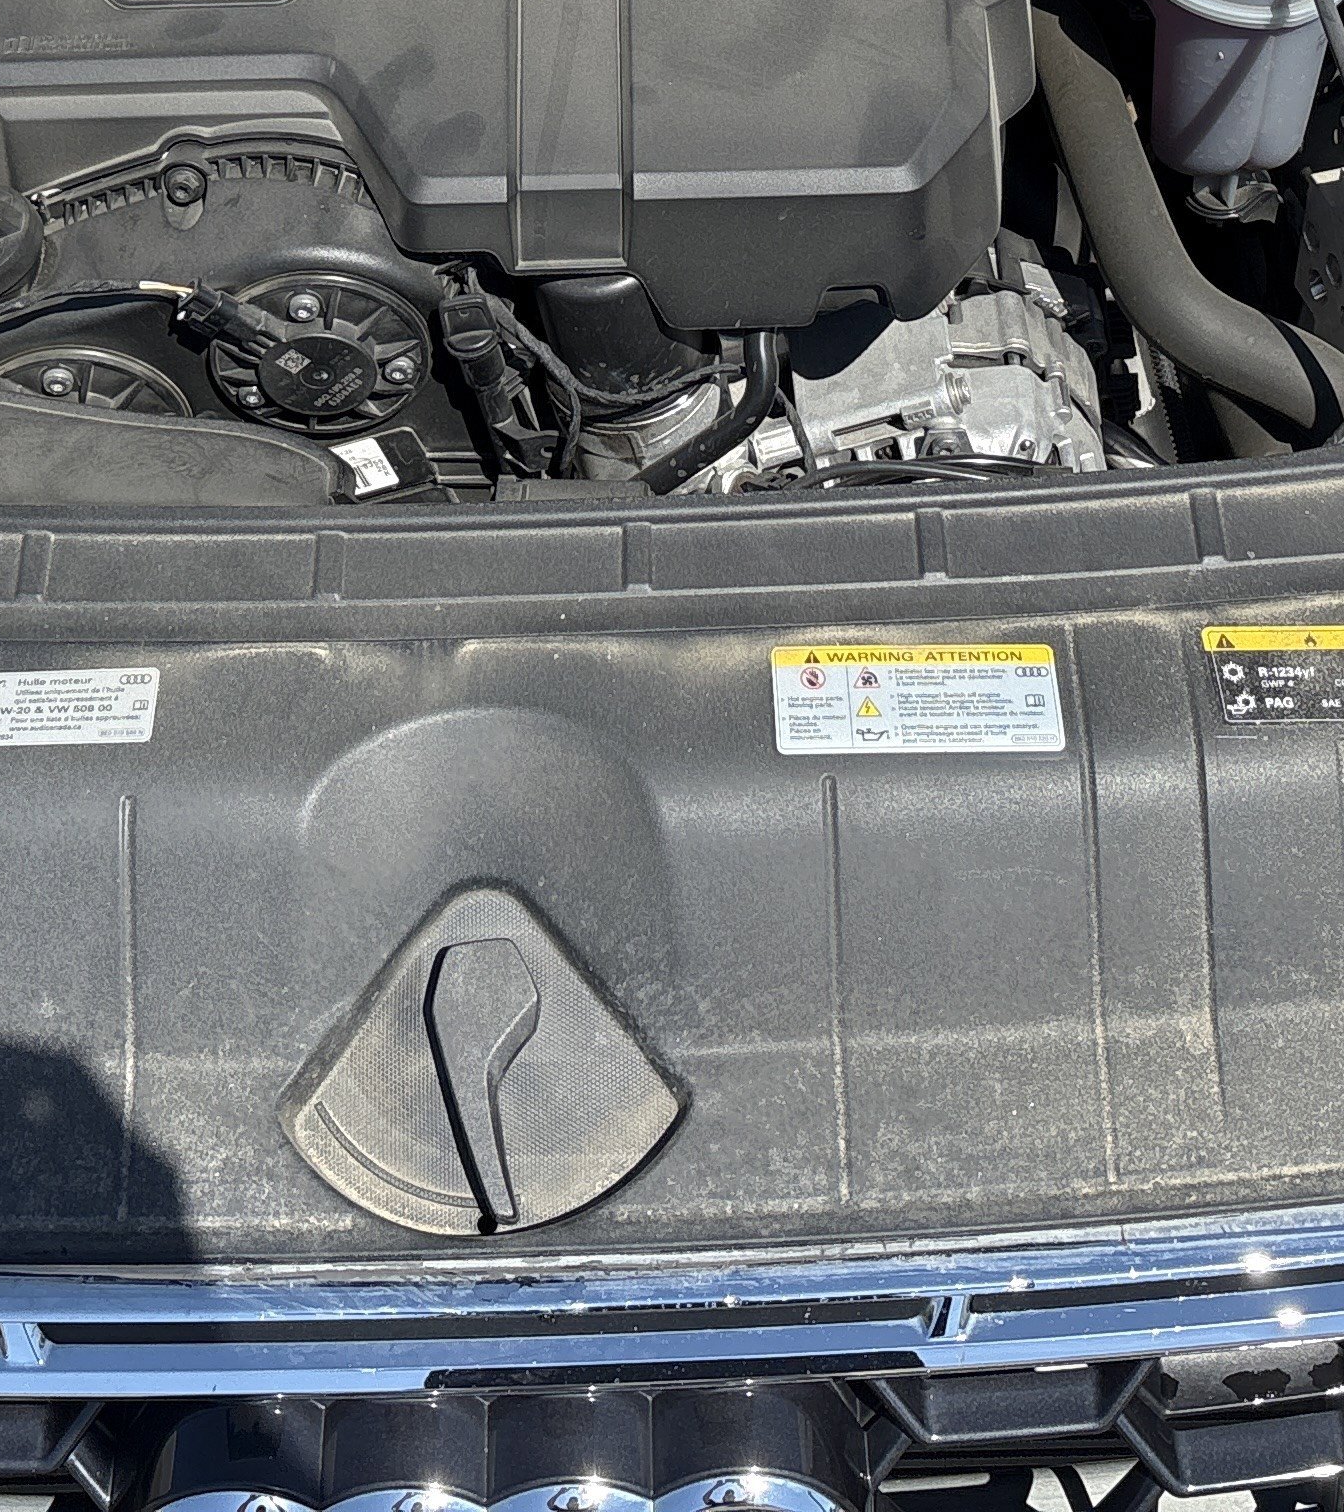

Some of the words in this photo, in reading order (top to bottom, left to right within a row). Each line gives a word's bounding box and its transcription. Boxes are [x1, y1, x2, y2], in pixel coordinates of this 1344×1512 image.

[827, 651, 914, 662] WARNING
[925, 651, 1022, 661] ATTENTION
[1258, 667, 1314, 679] R-1234yf
[18, 678, 46, 686] Huile
[1261, 680, 1285, 688] GWP
[1265, 697, 1294, 708] PAG
[1322, 699, 1342, 707] SAE
